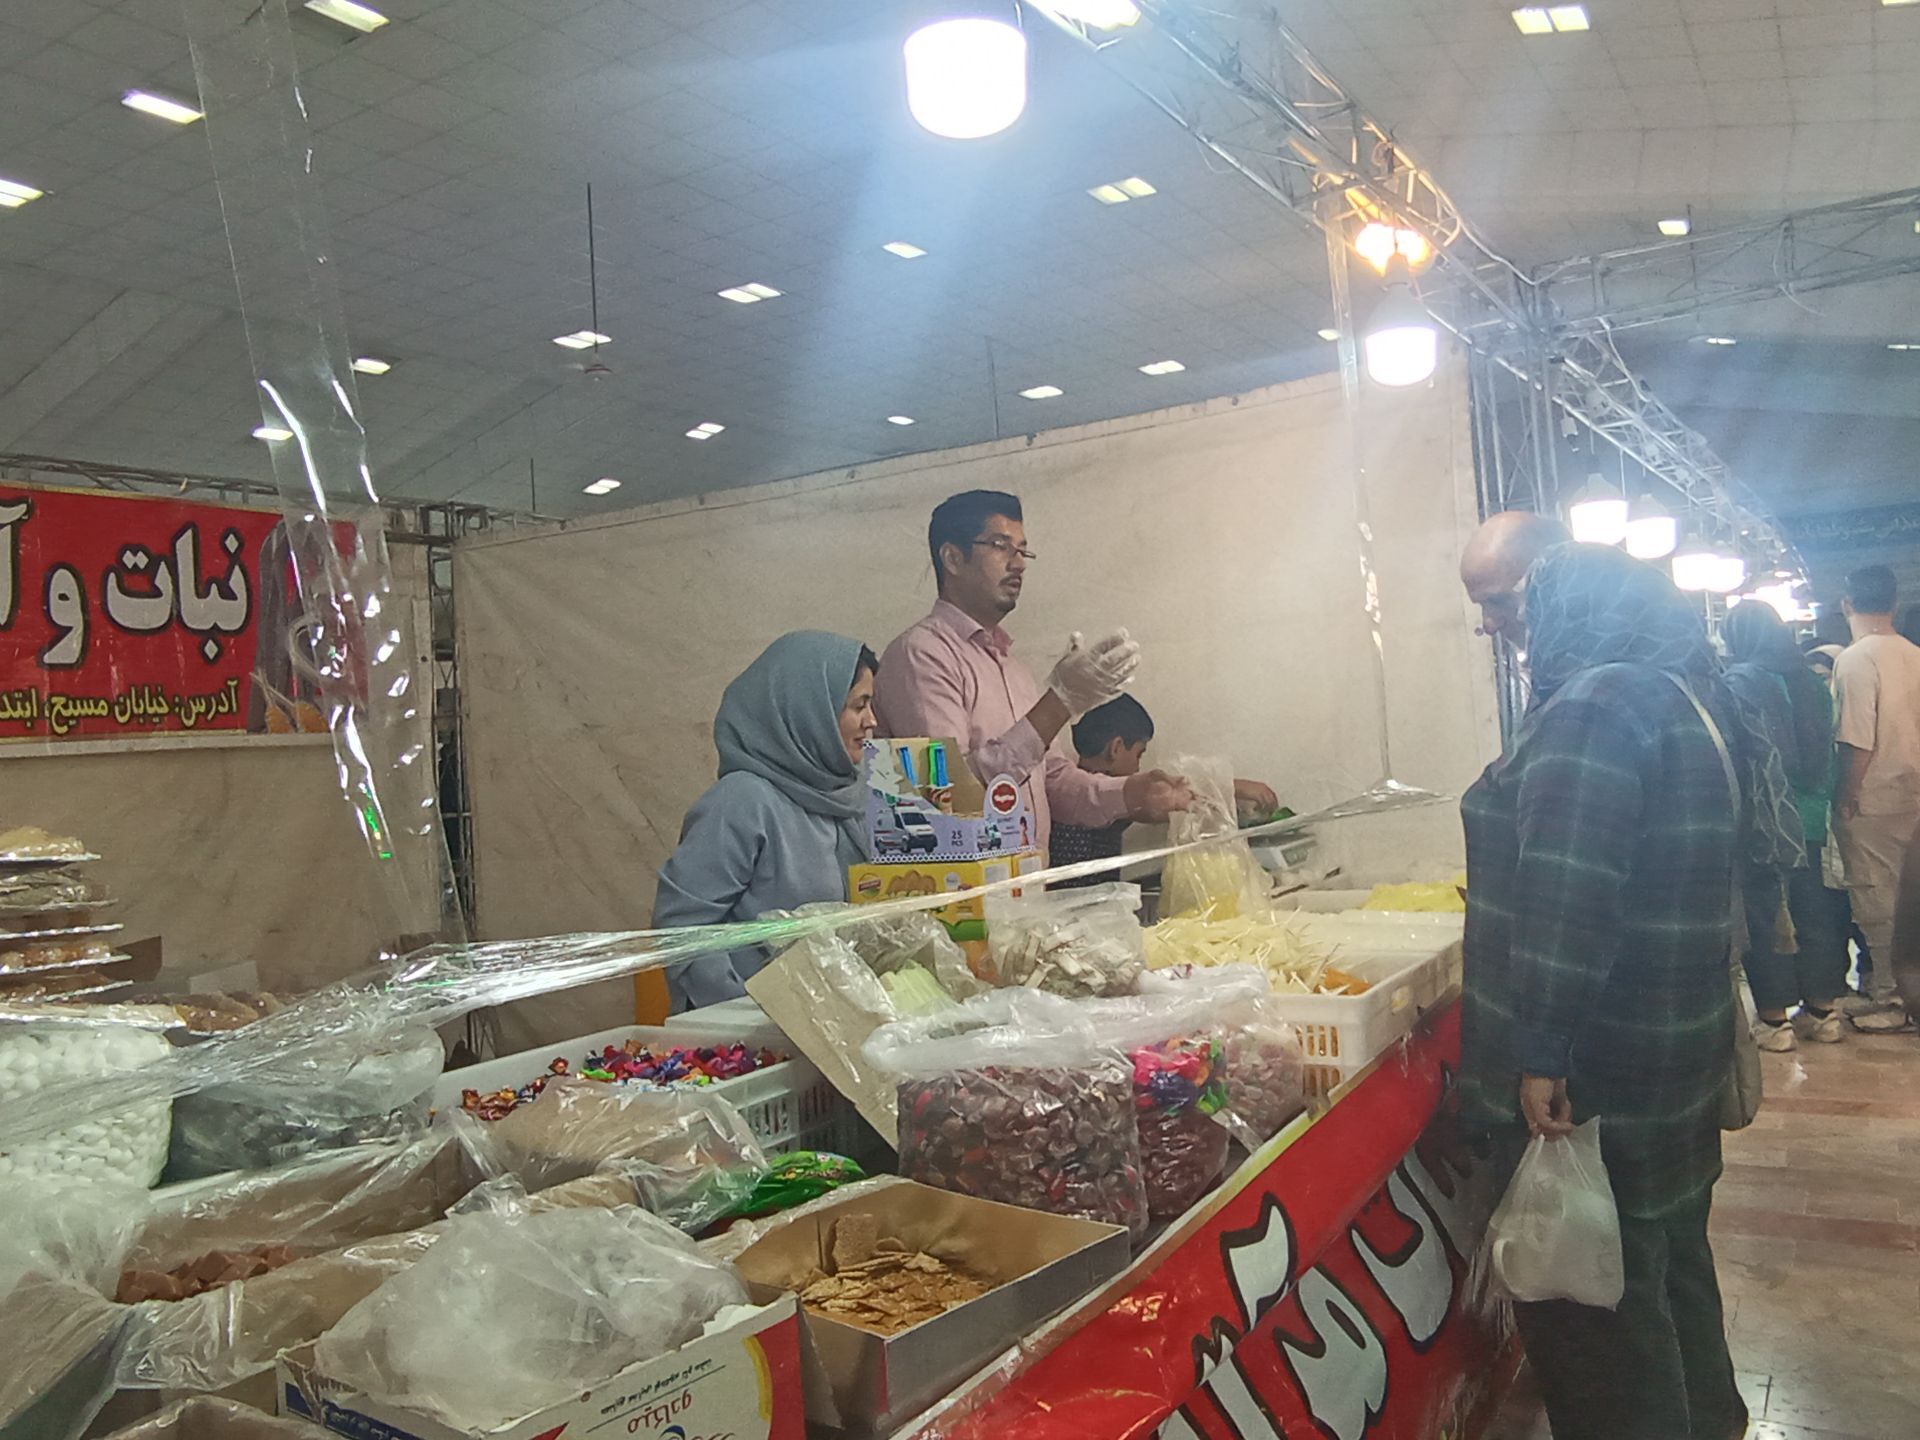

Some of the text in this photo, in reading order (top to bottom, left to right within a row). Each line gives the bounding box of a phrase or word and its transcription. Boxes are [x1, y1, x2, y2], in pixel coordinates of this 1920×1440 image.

[41, 566, 86, 666] و
[104, 524, 251, 662] نبات
[114, 685, 170, 724] خیابان
[175, 680, 239, 727] آدرس:
[951, 830, 963, 840] 25
